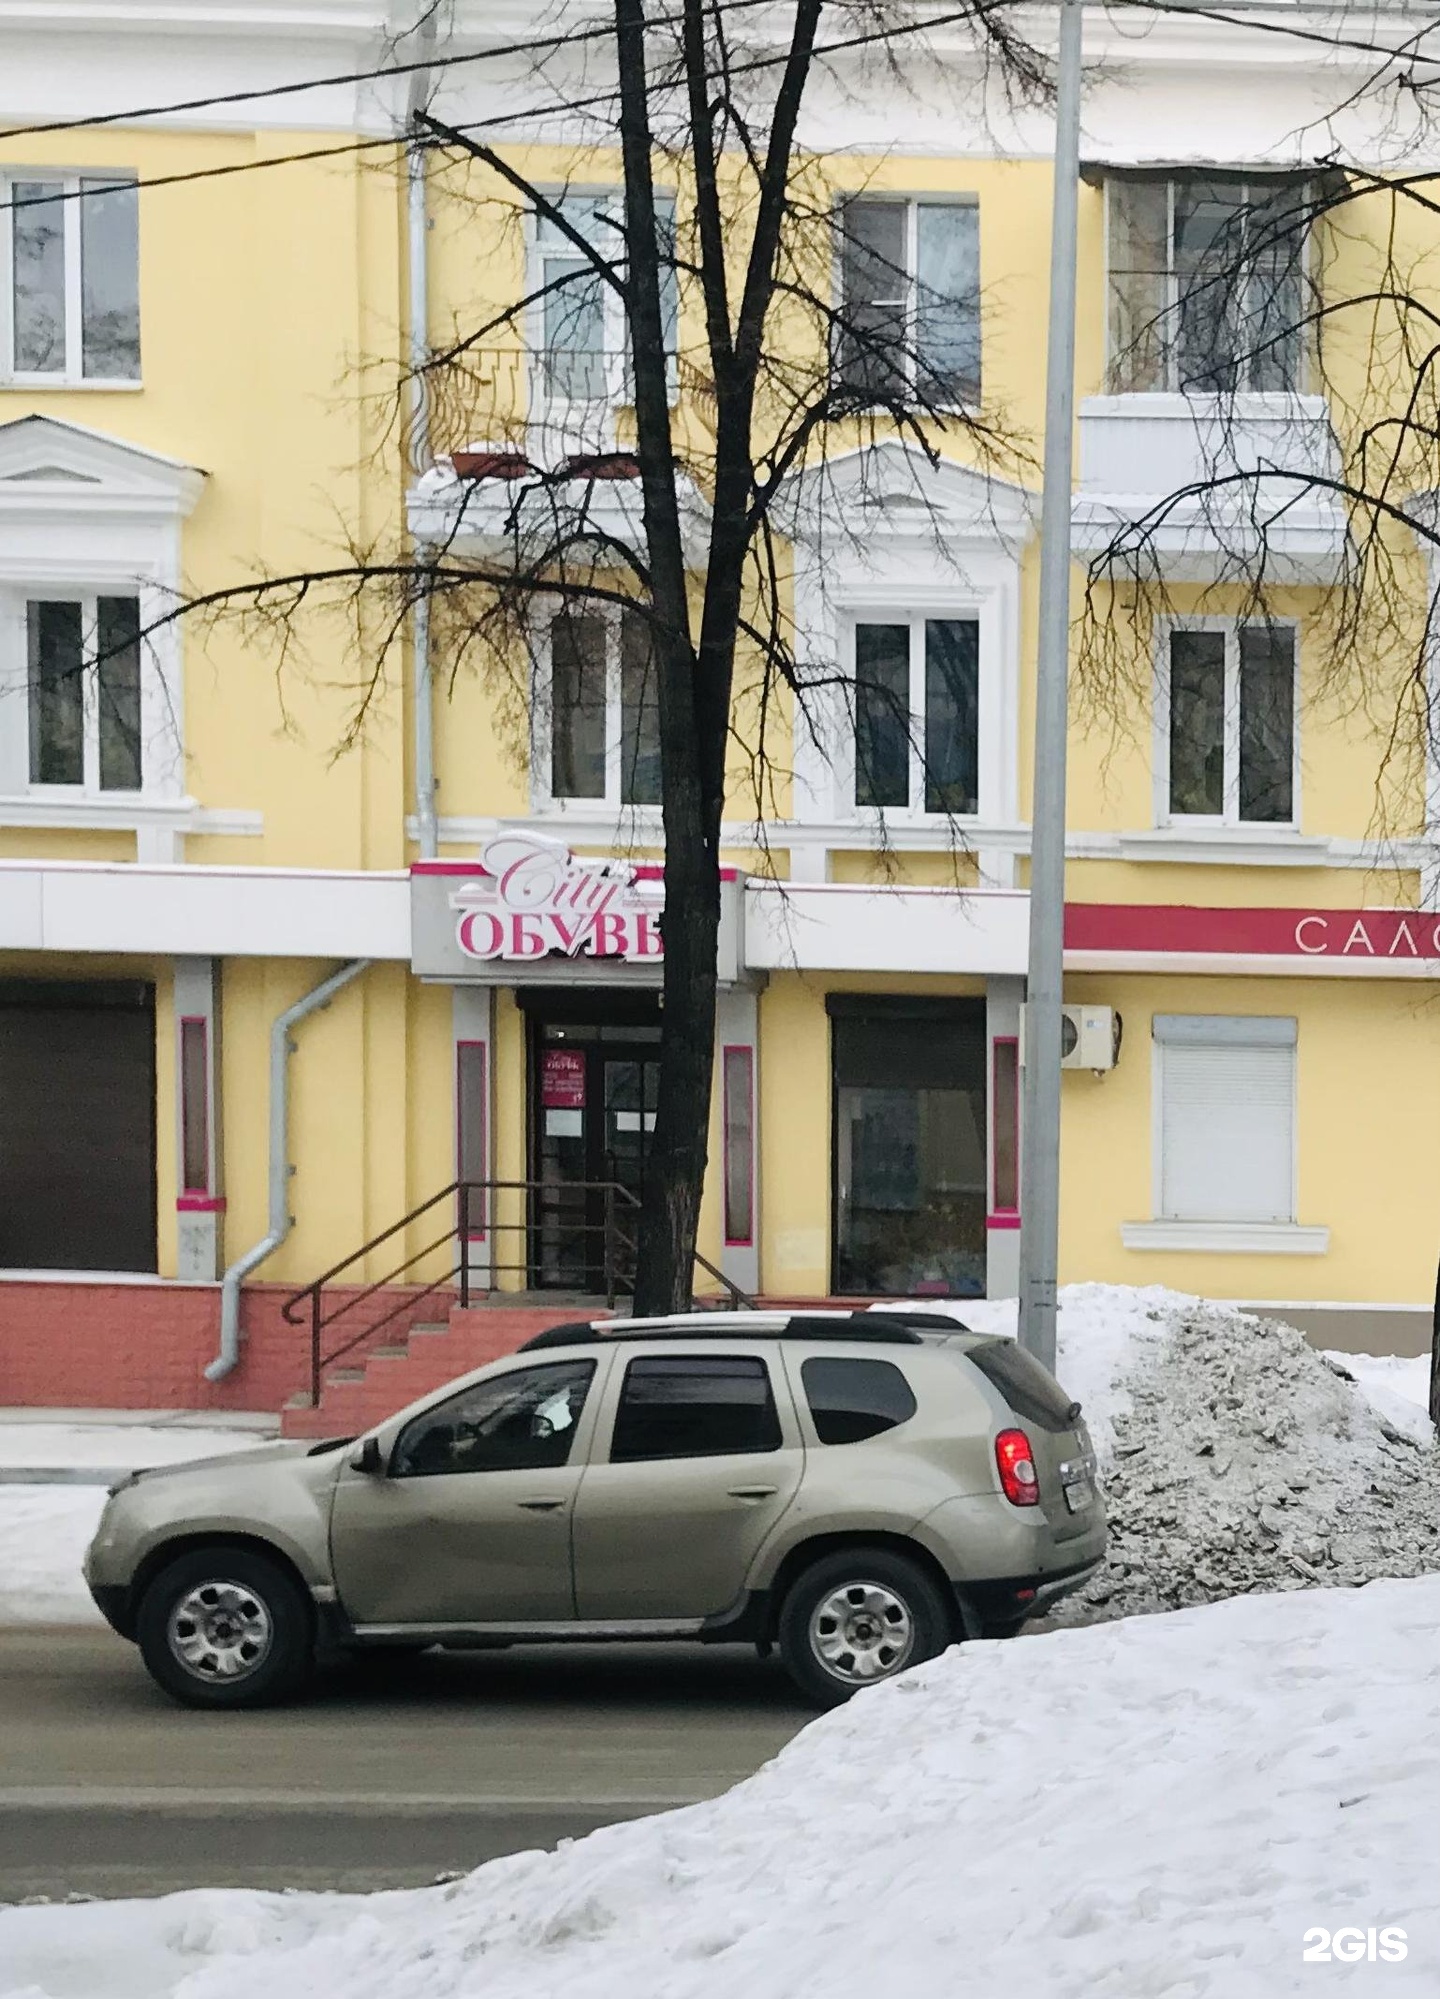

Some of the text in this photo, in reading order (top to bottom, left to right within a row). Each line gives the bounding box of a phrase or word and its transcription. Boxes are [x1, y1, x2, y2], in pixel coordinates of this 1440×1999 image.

[484, 838, 622, 953] City
[460, 912, 665, 956] ОБУВЬ
[1295, 916, 1440, 955] САЛ
